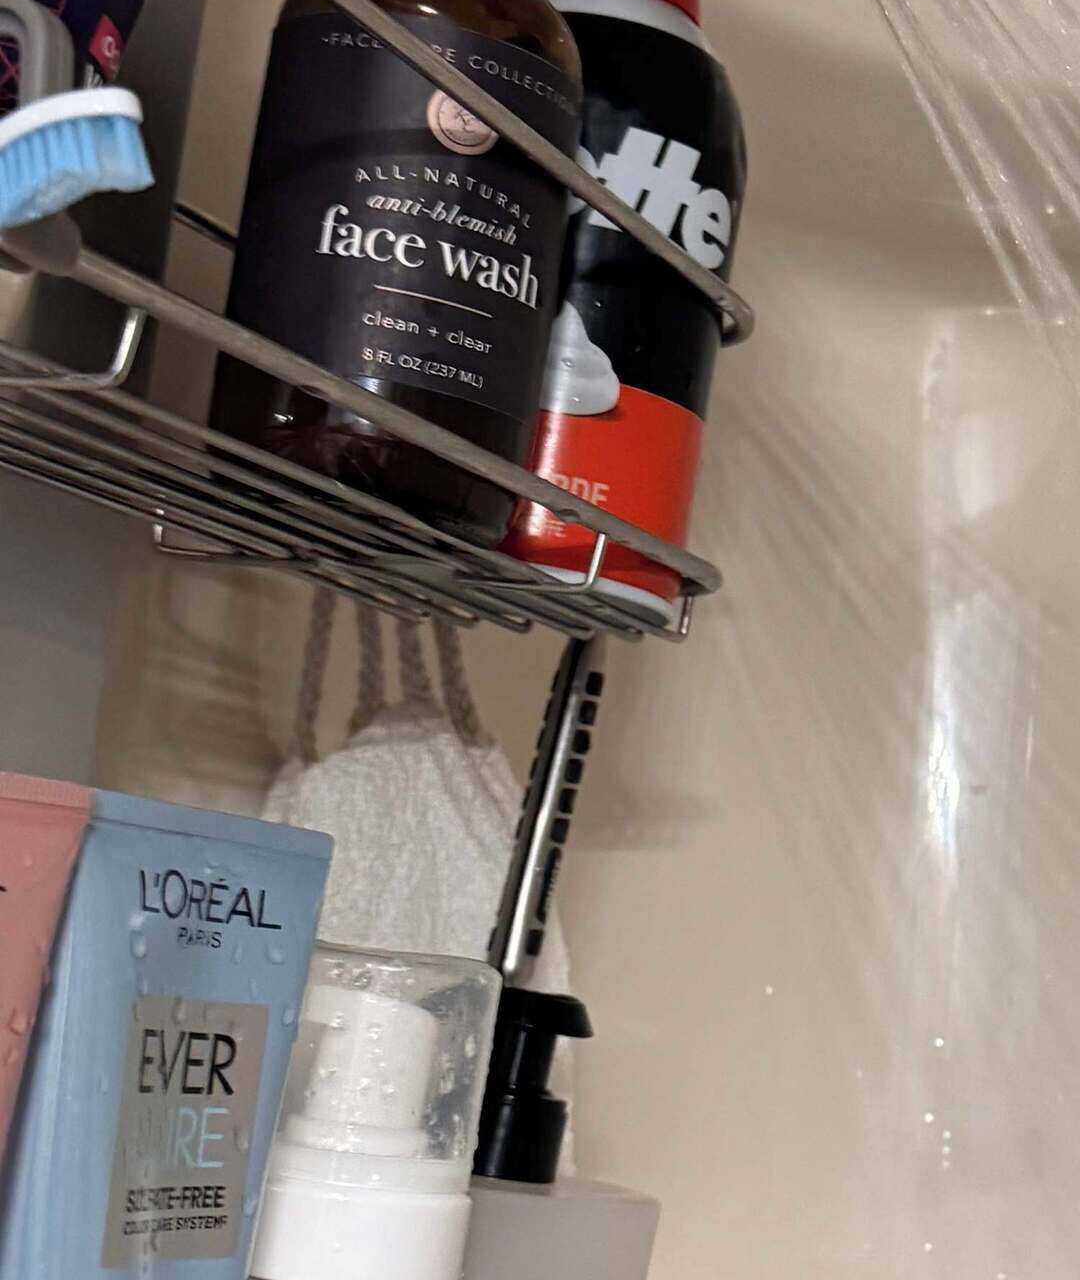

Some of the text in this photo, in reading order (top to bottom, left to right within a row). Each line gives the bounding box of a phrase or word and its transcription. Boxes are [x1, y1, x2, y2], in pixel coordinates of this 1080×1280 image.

[354, 164, 532, 230] ALL-NATURAL
[366, 193, 517, 246] anti-blemish
[567, 126, 732, 270] tte
[315, 204, 538, 310] face wash
[361, 311, 420, 335] clean
[447, 330, 493, 354] clear
[361, 347, 374, 361] 8
[377, 352, 395, 366] FL
[398, 354, 421, 371] OZ
[424, 360, 455, 378] (237
[140, 869, 282, 930] L'ORÉAL
[177, 927, 223, 950] PARIS
[138, 1029, 237, 1096] EVER
